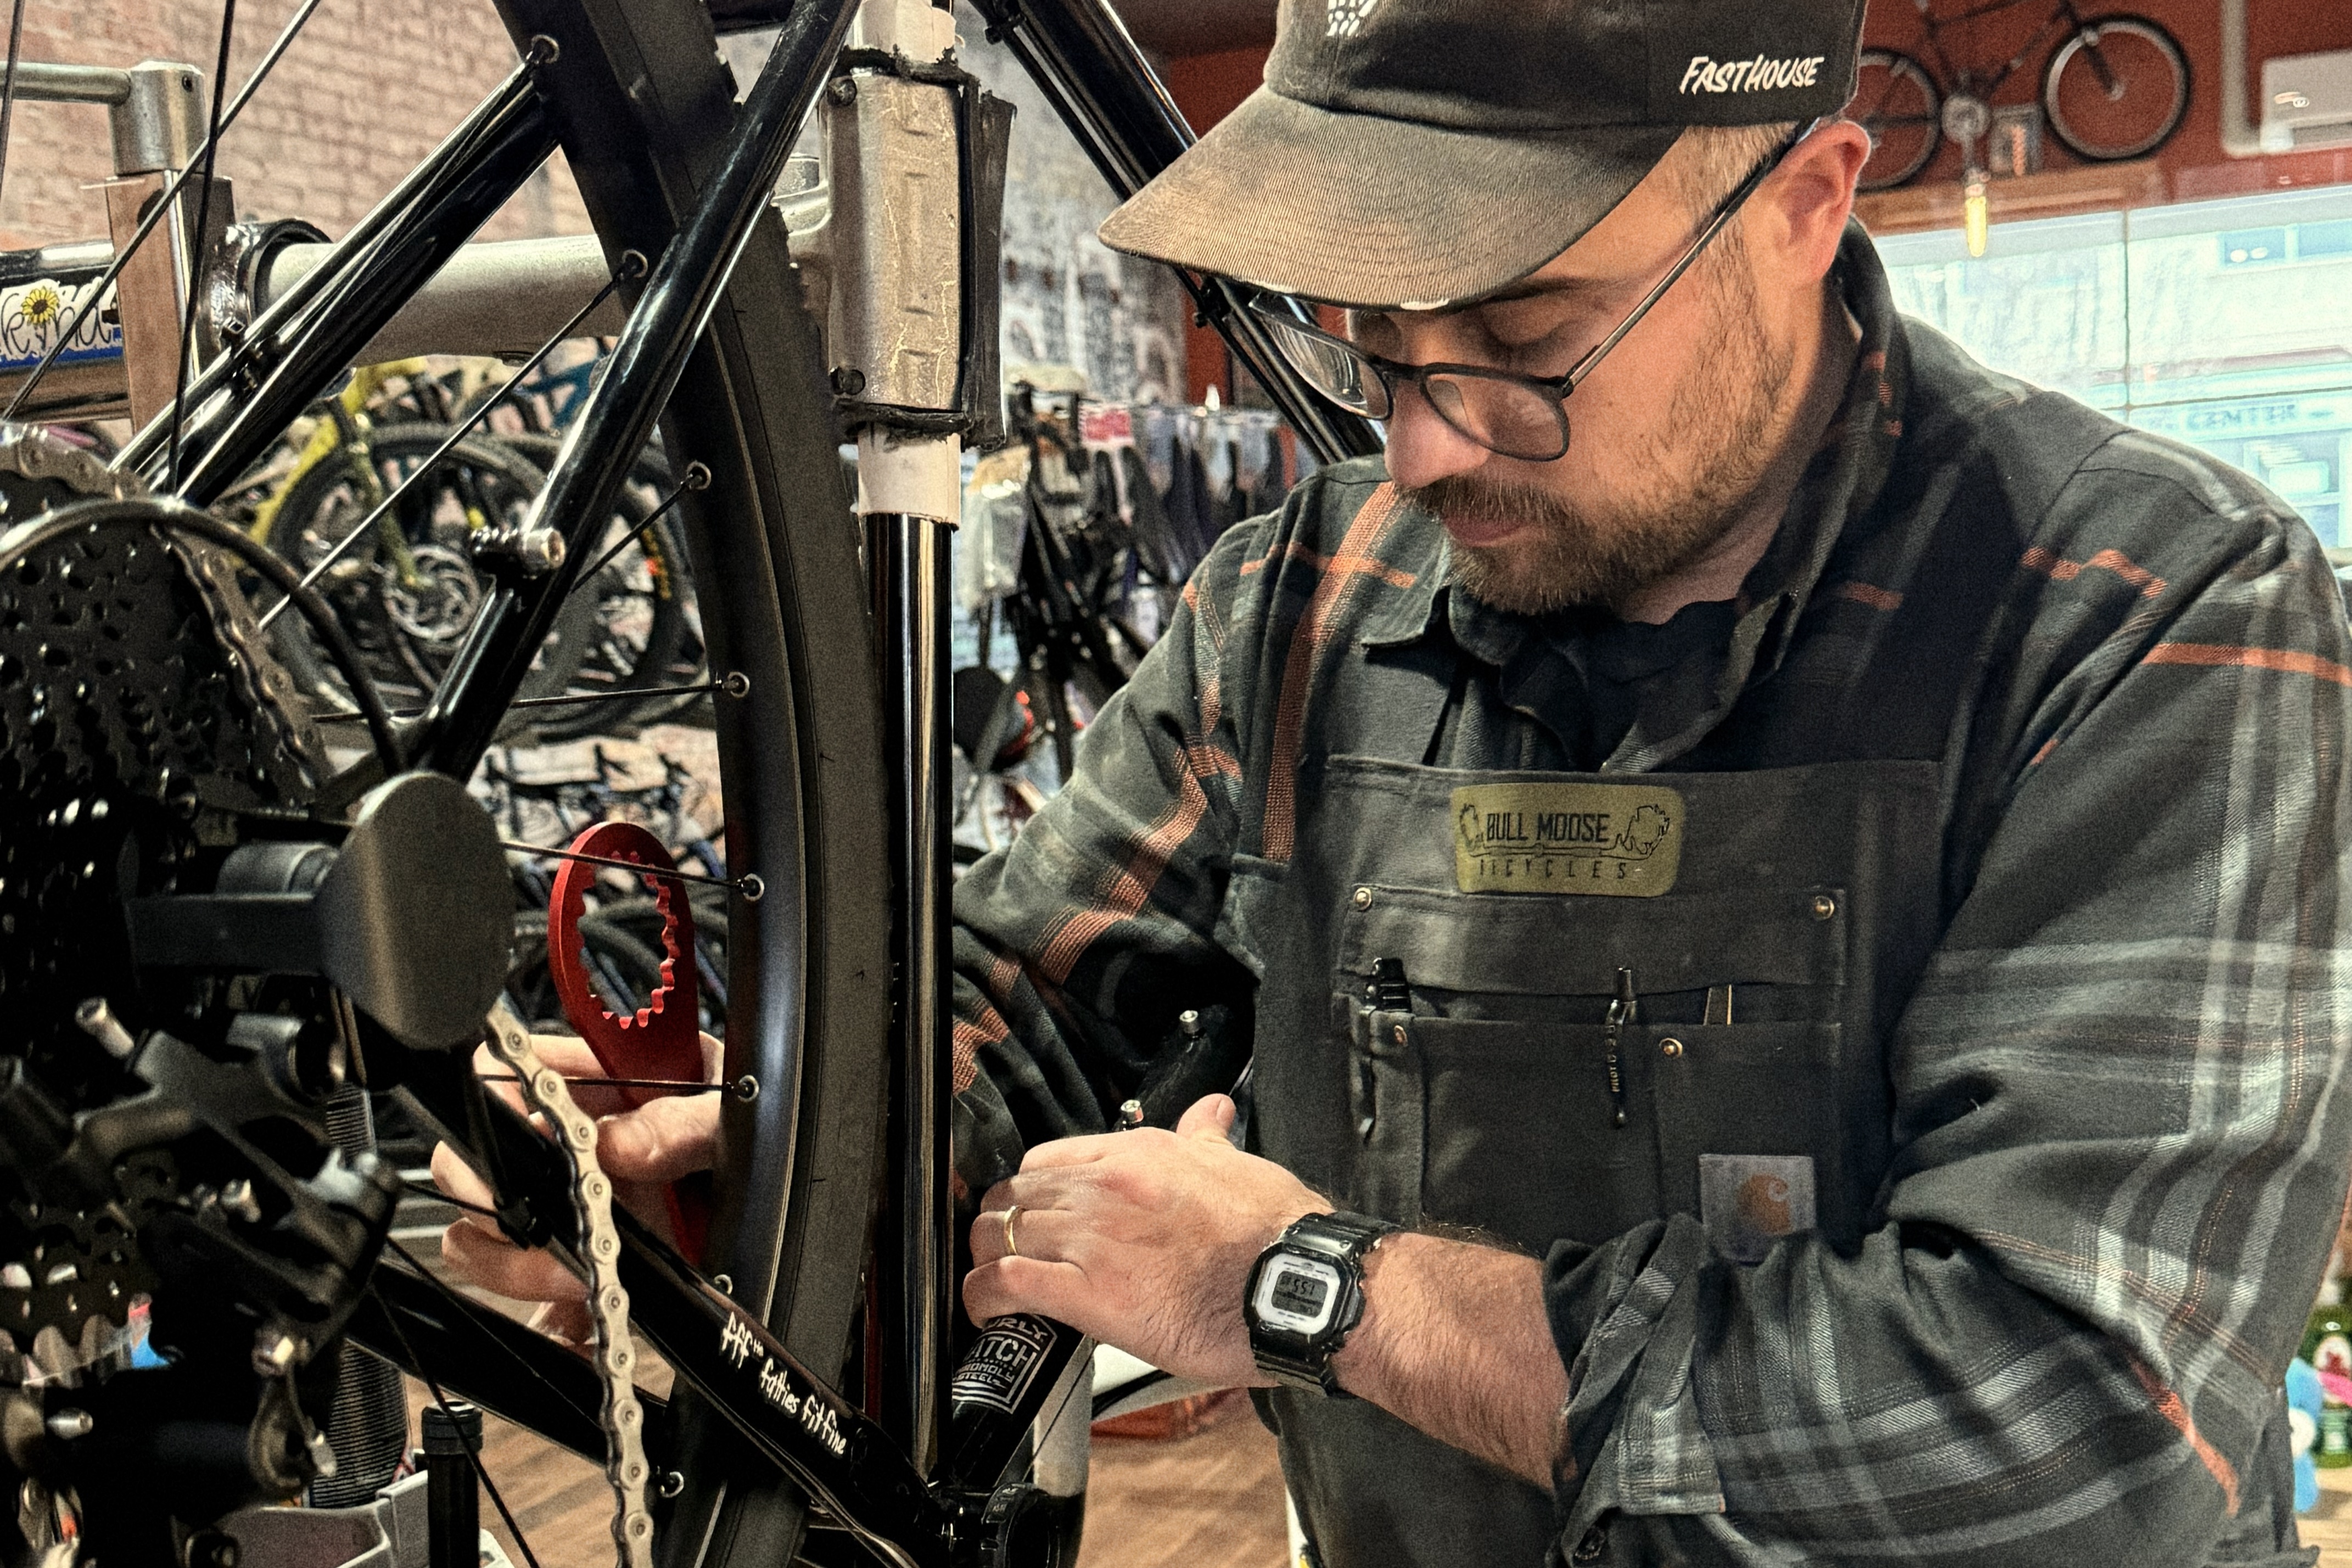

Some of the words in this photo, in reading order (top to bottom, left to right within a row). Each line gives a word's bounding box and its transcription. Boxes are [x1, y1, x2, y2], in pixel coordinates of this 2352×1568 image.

[1679, 54, 1826, 96] FASTHOUSE
[1486, 812, 1528, 842] BULL
[1537, 813, 1612, 844] MOOSE
[982, 1317, 1049, 1340] URLY
[957, 1373, 993, 1384] STEEL
